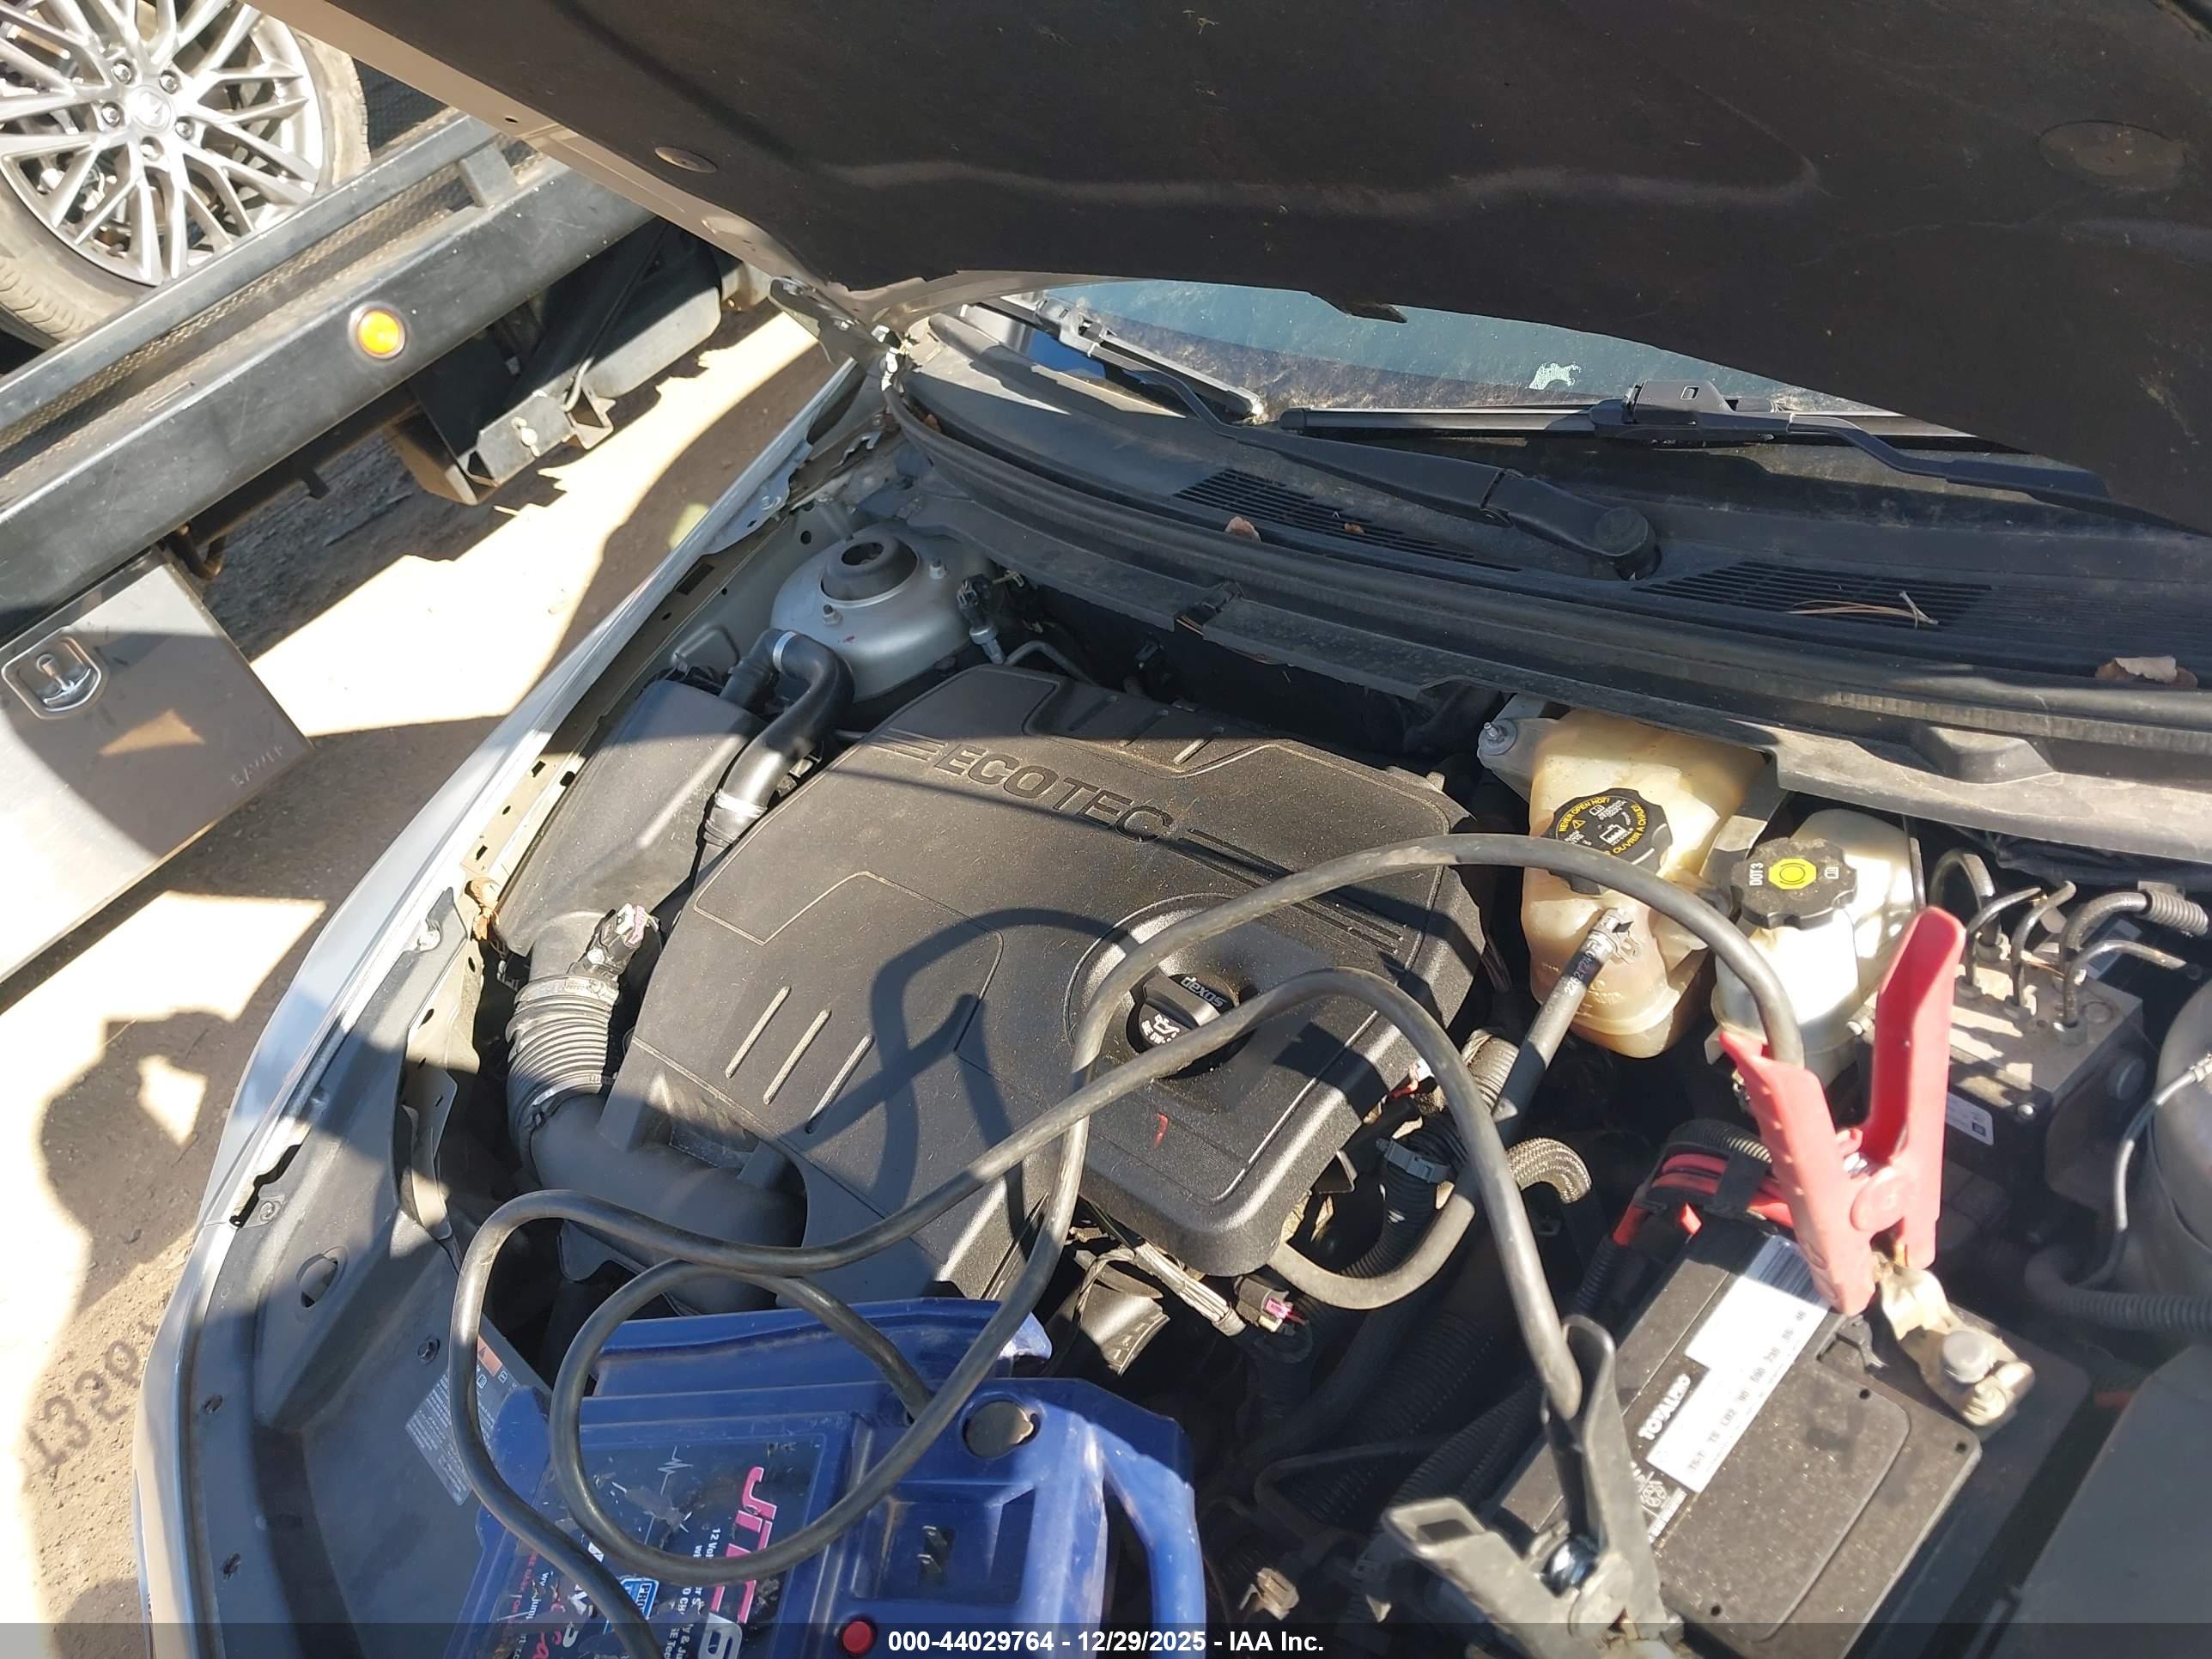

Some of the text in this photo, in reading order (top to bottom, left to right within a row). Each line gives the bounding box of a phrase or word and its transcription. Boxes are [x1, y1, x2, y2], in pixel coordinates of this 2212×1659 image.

[933, 744, 1176, 843] ECOTEC
[1558, 813, 1576, 832] NEVER
[1573, 800, 1592, 815] OPEN
[1613, 832, 1643, 854] OUVRIR
[1180, 976, 1228, 1007] dexos
[709, 1527, 721, 1540] 12
[705, 1541, 718, 1559] Vol
